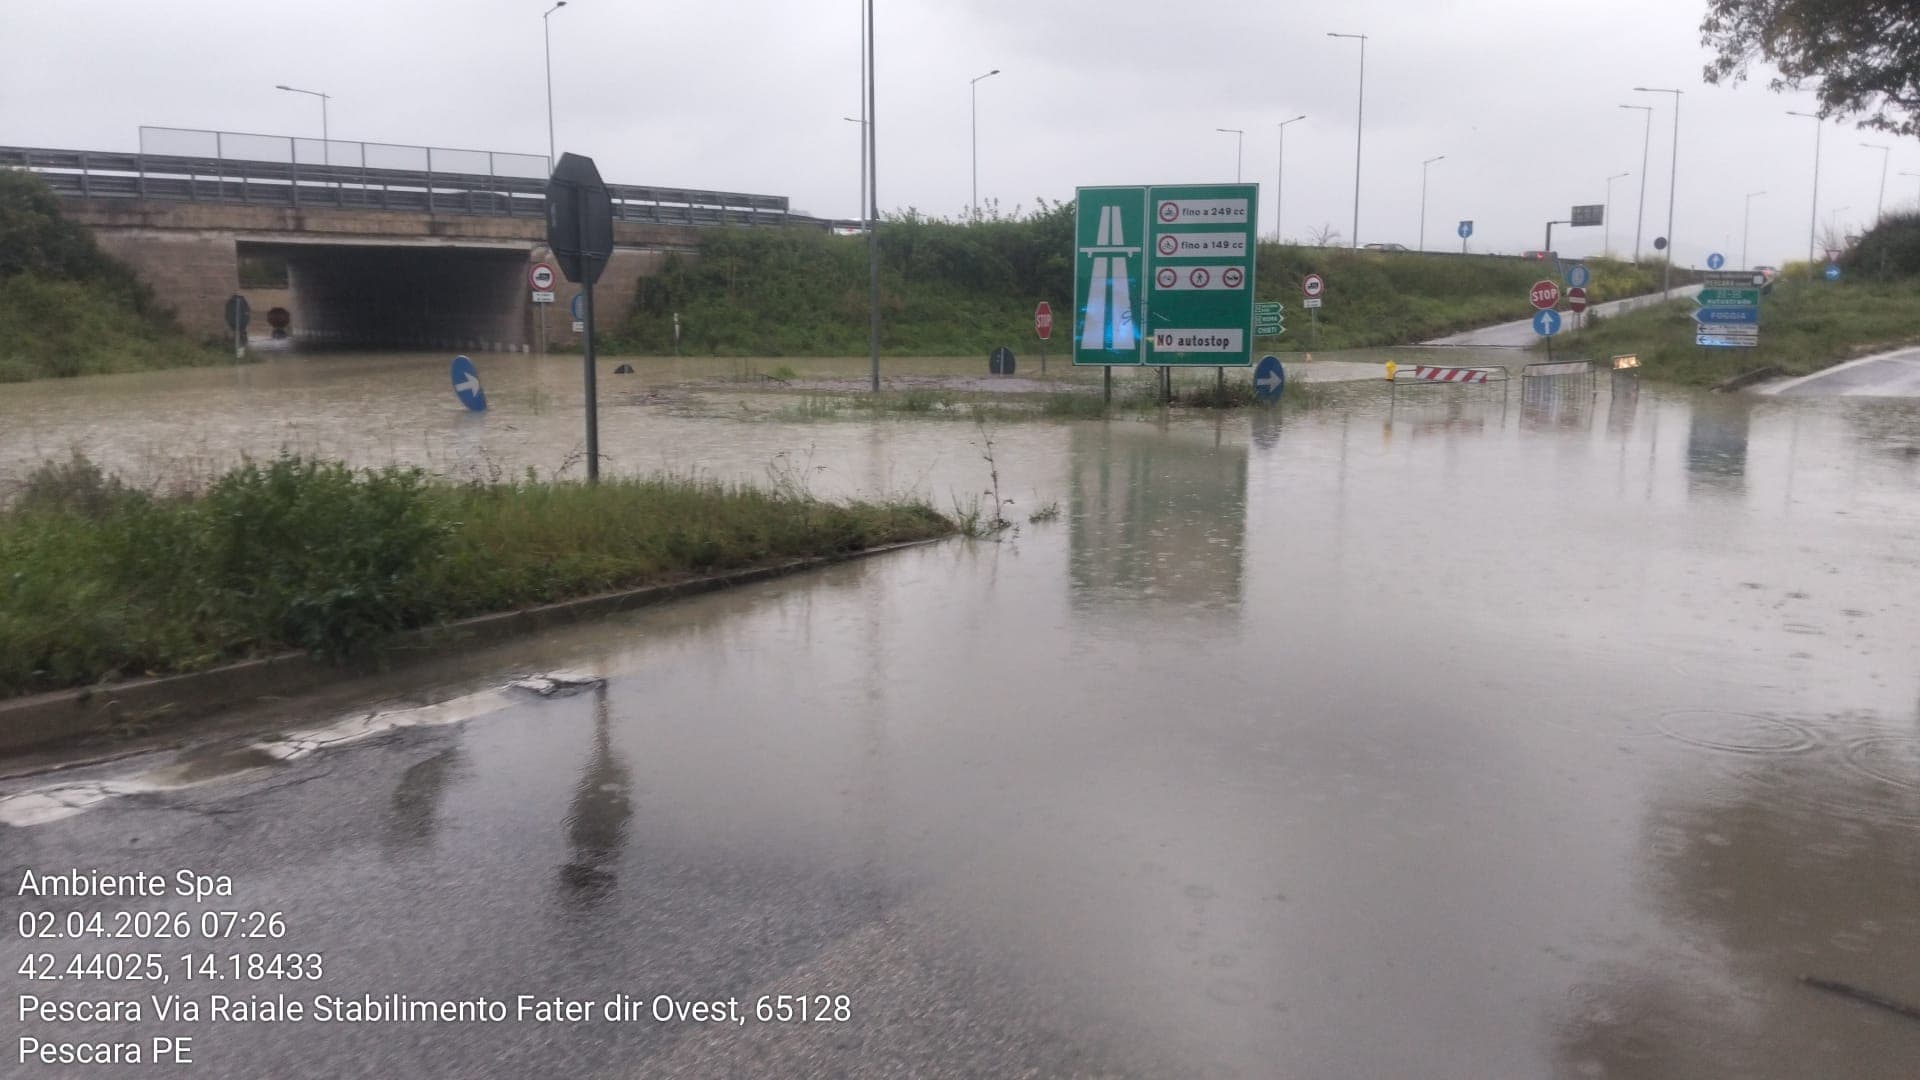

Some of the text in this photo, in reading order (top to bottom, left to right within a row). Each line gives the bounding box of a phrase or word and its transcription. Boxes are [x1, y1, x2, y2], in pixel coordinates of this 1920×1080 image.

[1182, 208, 1200, 216] fino
[1211, 207, 1232, 216] 249
[1181, 241, 1200, 250] fino
[1212, 241, 1230, 249] 149
[1532, 288, 1557, 301] STOP
[1157, 334, 1229, 350] NO autostop
